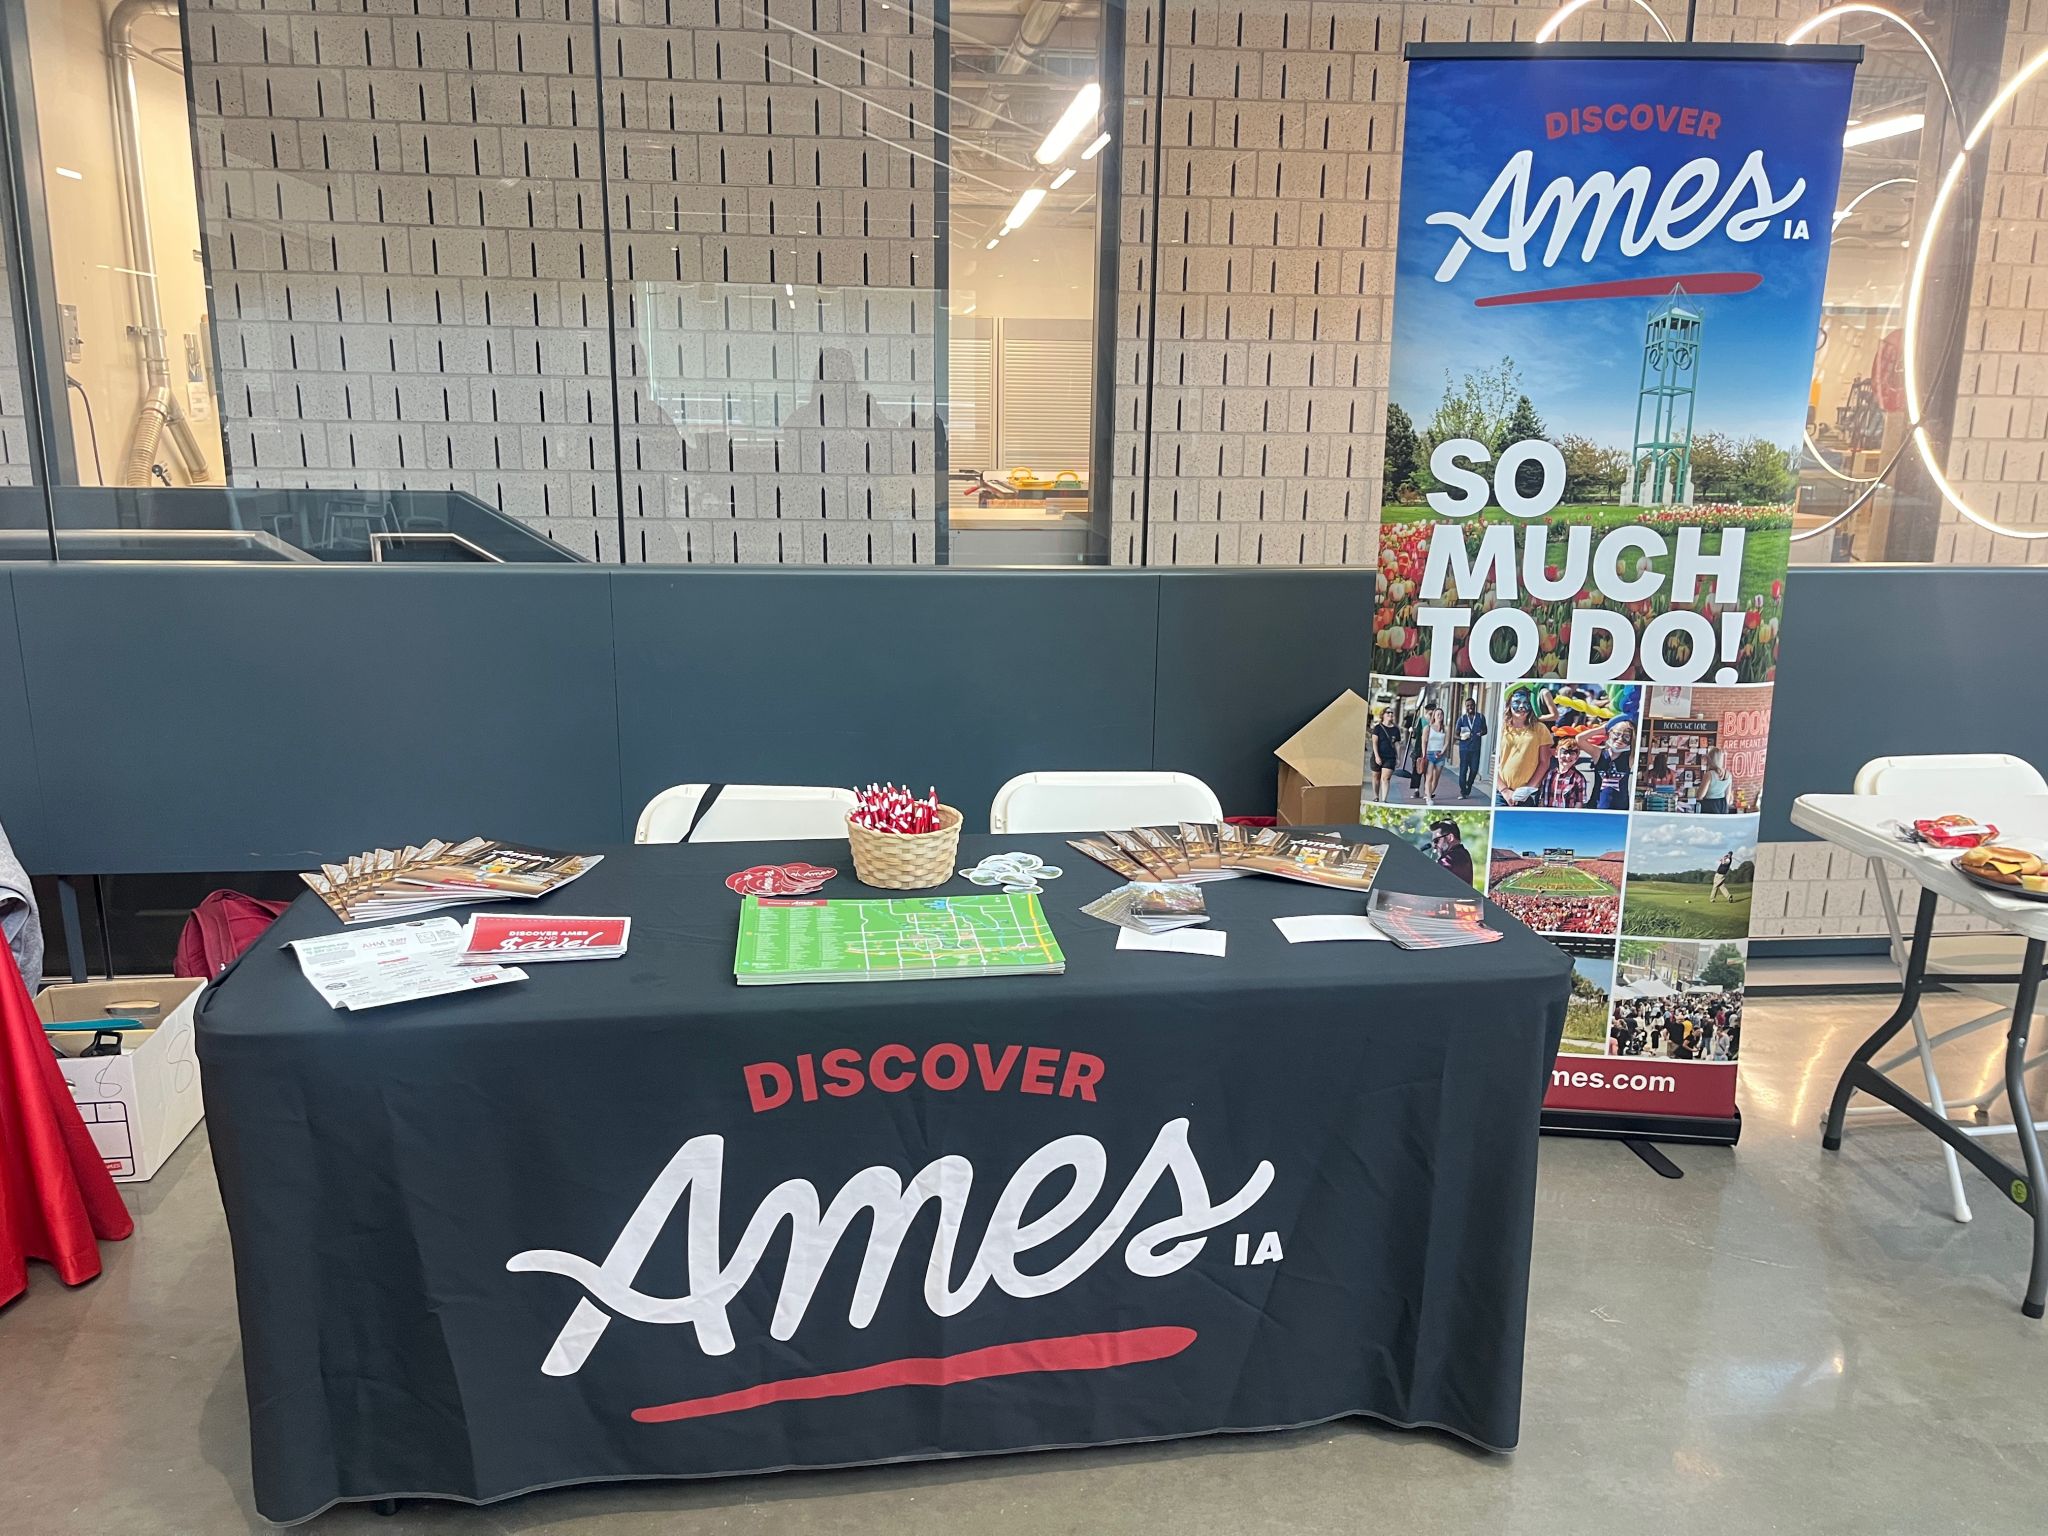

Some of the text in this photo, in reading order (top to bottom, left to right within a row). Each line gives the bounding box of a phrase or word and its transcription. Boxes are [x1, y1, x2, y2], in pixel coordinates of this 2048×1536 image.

[1545, 103, 1722, 140] DISCOVER
[1425, 149, 1810, 283] Ames IA
[1425, 438, 1567, 518] SO
[1418, 524, 1746, 603] MUCH
[1416, 606, 1746, 685] TO DO!
[1723, 739, 1738, 749] ARE
[742, 1043, 1106, 1113] DISCOVER
[505, 1117, 1284, 1377] Ames IA
